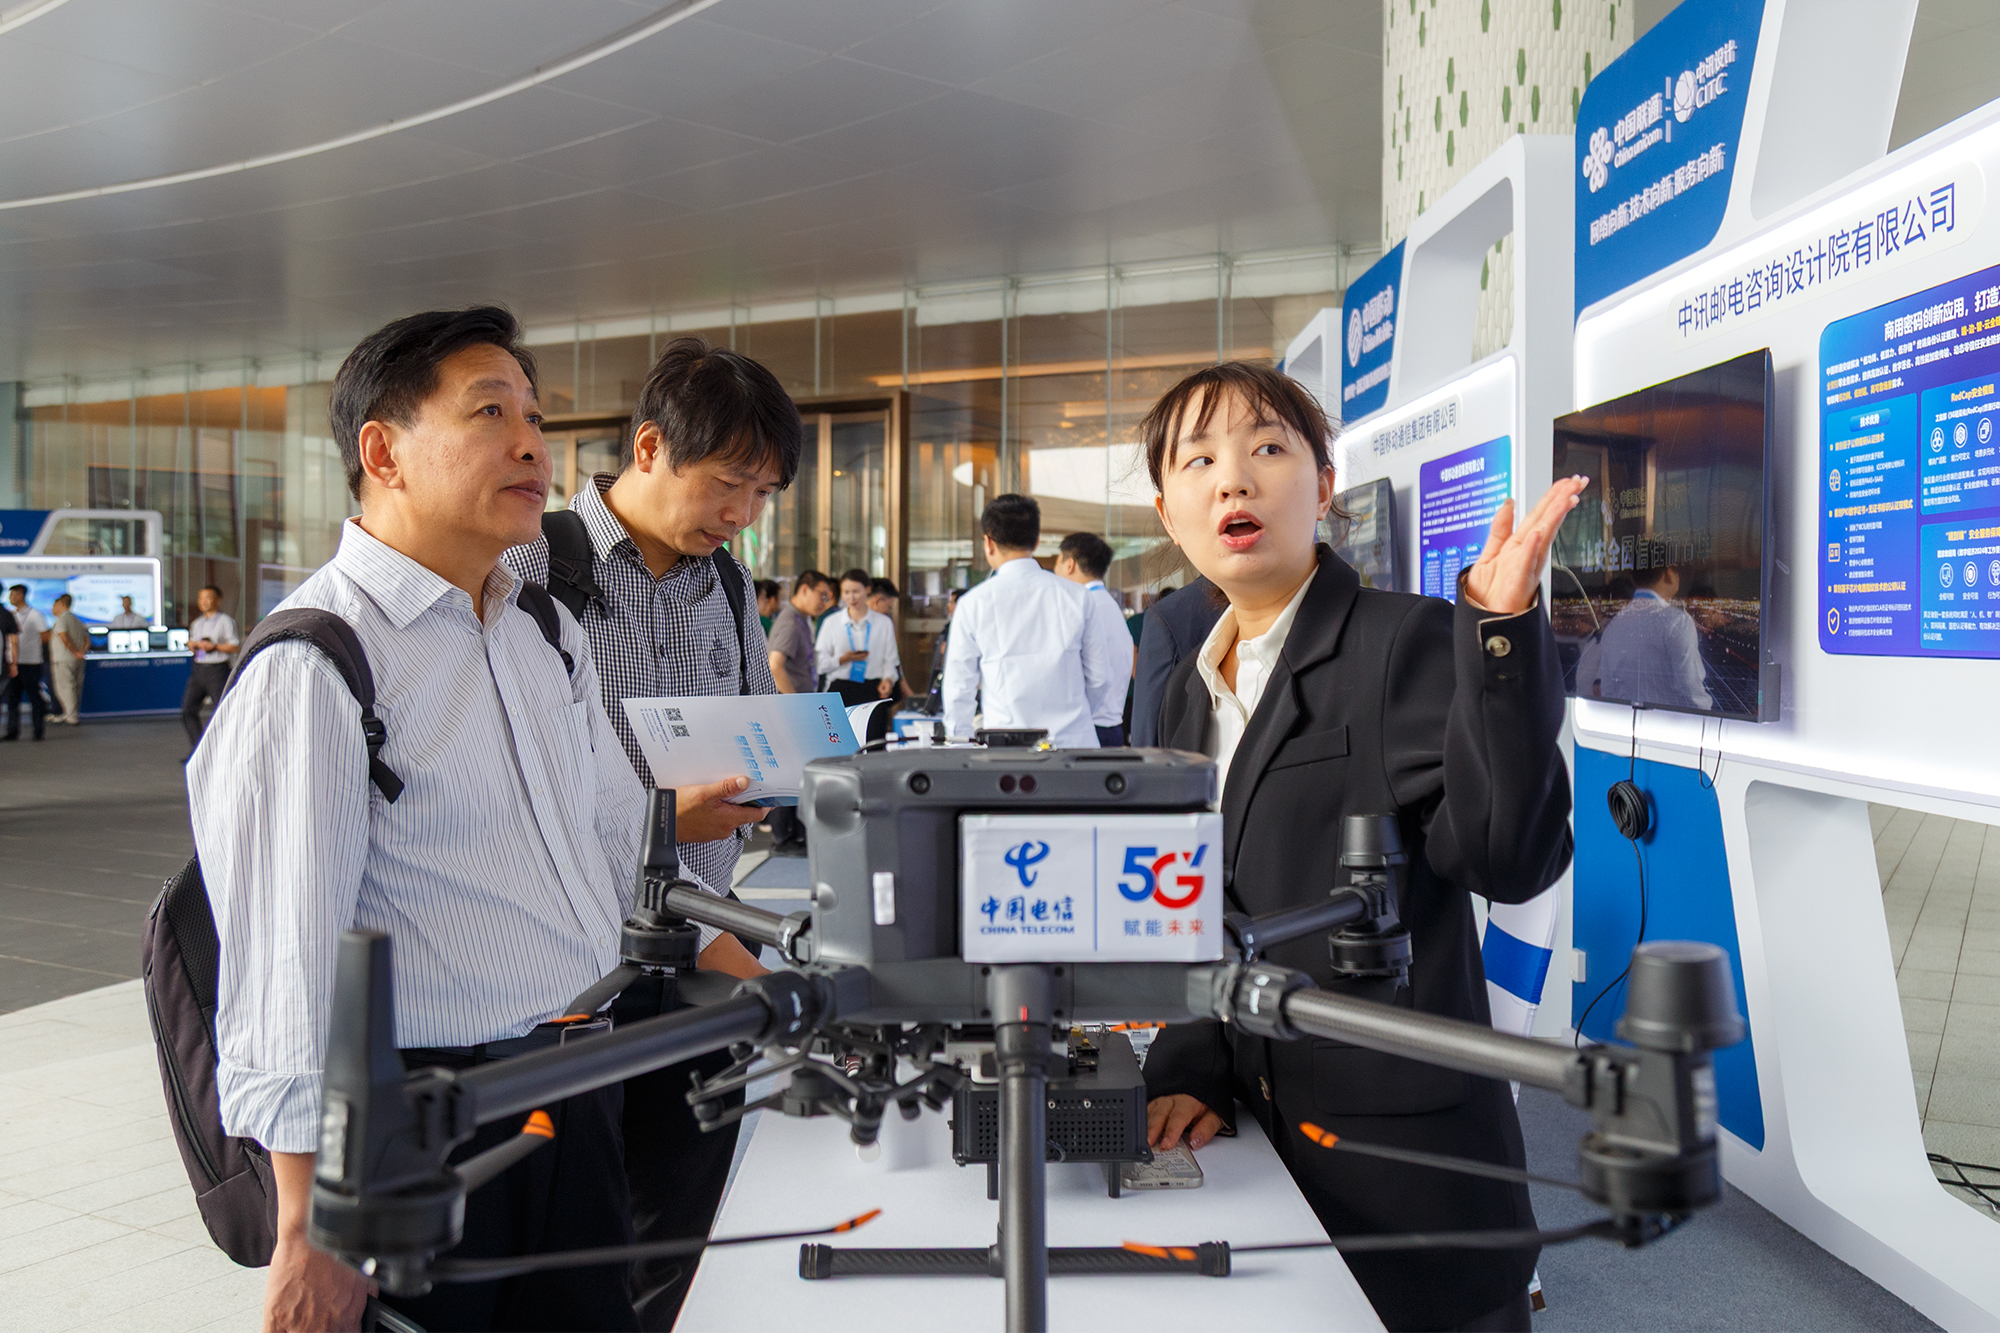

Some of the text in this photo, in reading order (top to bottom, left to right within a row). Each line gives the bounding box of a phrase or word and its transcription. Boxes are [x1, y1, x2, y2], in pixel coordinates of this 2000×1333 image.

[1696, 39, 1738, 84] 中讯设计
[1696, 72, 1728, 109] CITC
[1614, 92, 1663, 147] 中国联通
[1590, 143, 1725, 246] 网络向新 技术向新 服务向新
[1678, 182, 1957, 338] 中讯邮电咨询设计院有限公司
[1362, 285, 1394, 332] 中国移动
[1884, 285, 2000, 342] 商用密码创新应用，打造
[1373, 403, 1457, 458] 中国移动通信集团有限公司
[828, 732, 842, 744] 5G
[1117, 844, 1209, 910] 5G
[981, 895, 1075, 925] 中国电信
[981, 926, 1075, 935] CHINA TELECOM
[1124, 918, 1206, 937] 赋能未来
